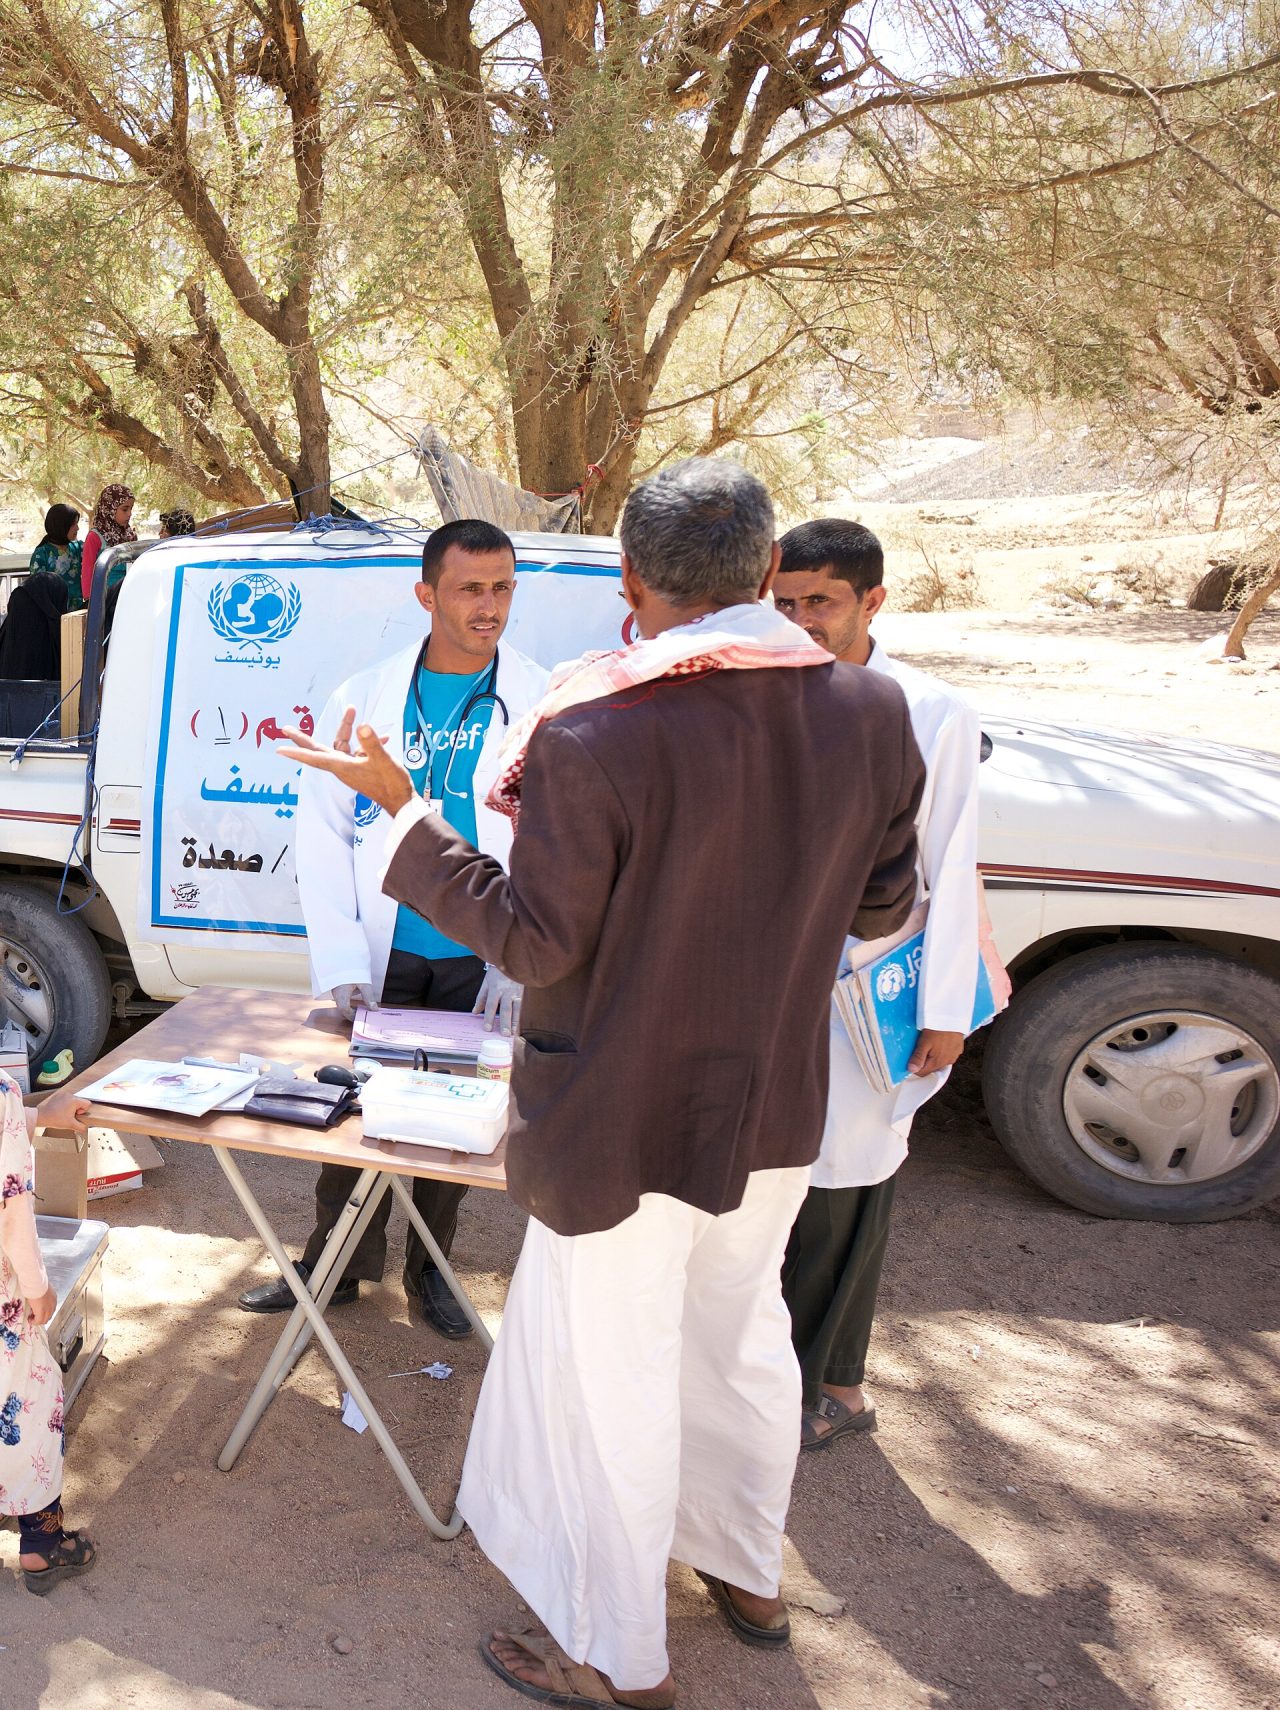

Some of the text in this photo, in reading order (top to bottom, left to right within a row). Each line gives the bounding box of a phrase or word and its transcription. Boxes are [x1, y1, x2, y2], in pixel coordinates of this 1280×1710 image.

[214, 651, 281, 669] يونيسف
[256, 705, 314, 749] قم
[405, 723, 483, 751] nicef
[180, 836, 264, 873] صعدة
